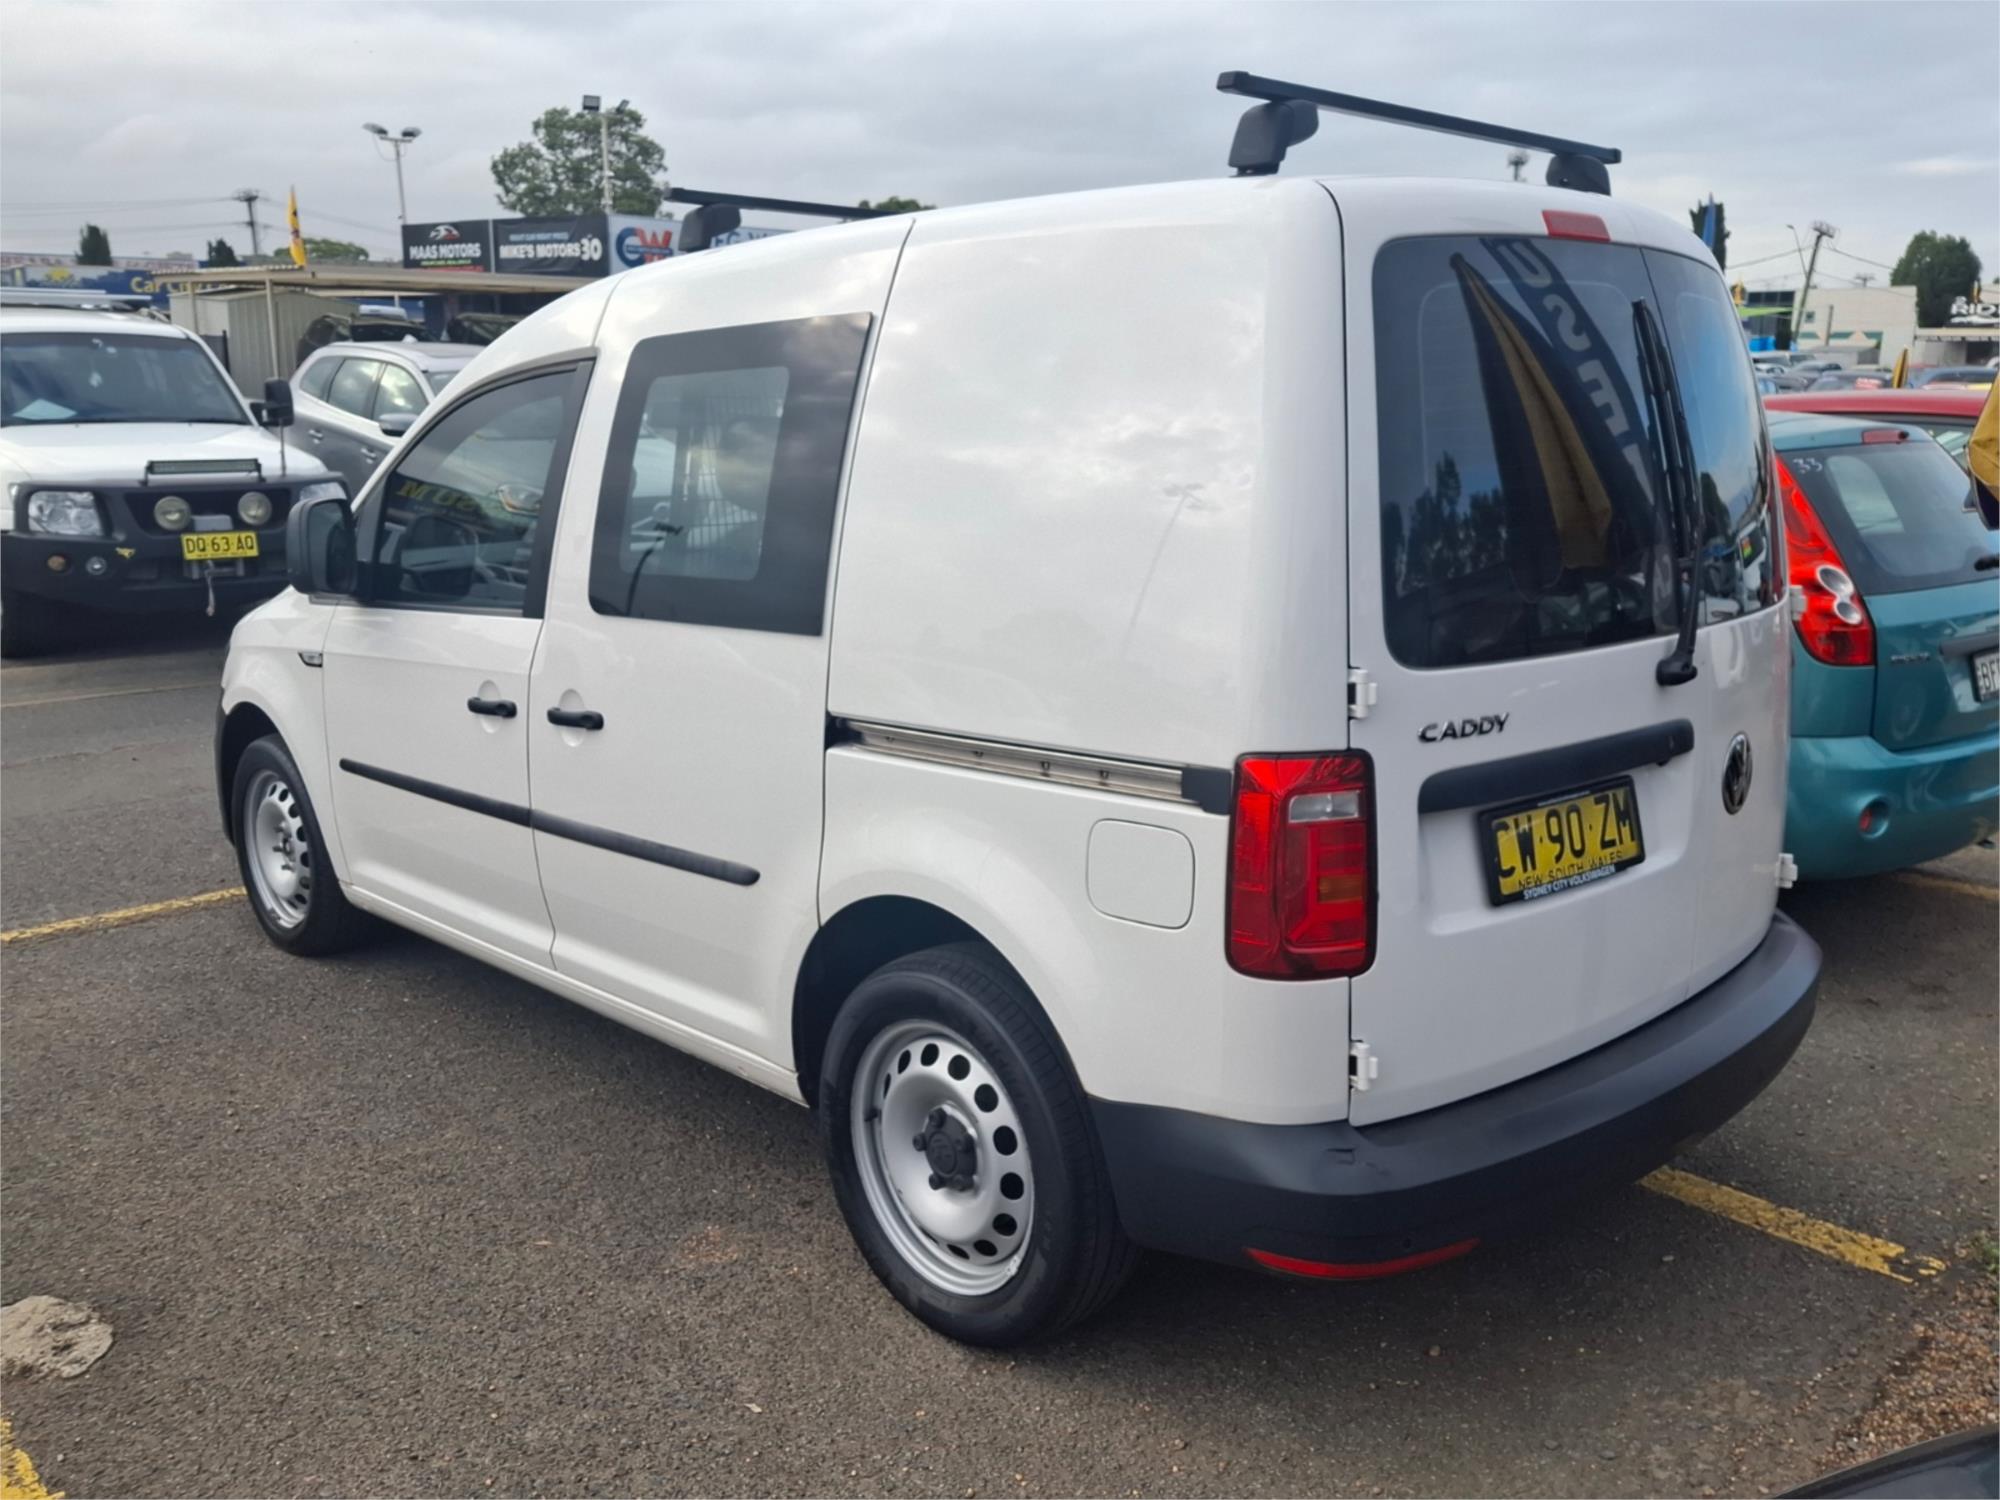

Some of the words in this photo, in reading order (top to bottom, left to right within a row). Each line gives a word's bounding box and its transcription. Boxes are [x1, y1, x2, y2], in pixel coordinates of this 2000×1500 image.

[439, 242, 482, 258] MOTORS
[536, 242, 580, 257] MOTORS
[581, 238, 602, 261] 30
[1952, 303, 2000, 316] RID
[1418, 712, 1510, 743] CADDY
[1519, 874, 1543, 889] NEW
[1549, 862, 1584, 881] SOUTH
[1590, 850, 1623, 869] WALES
[1523, 884, 1552, 900] SYDNEY
[1552, 879, 1569, 892] CITY
[1569, 864, 1617, 887] VOLKSWAGEN
